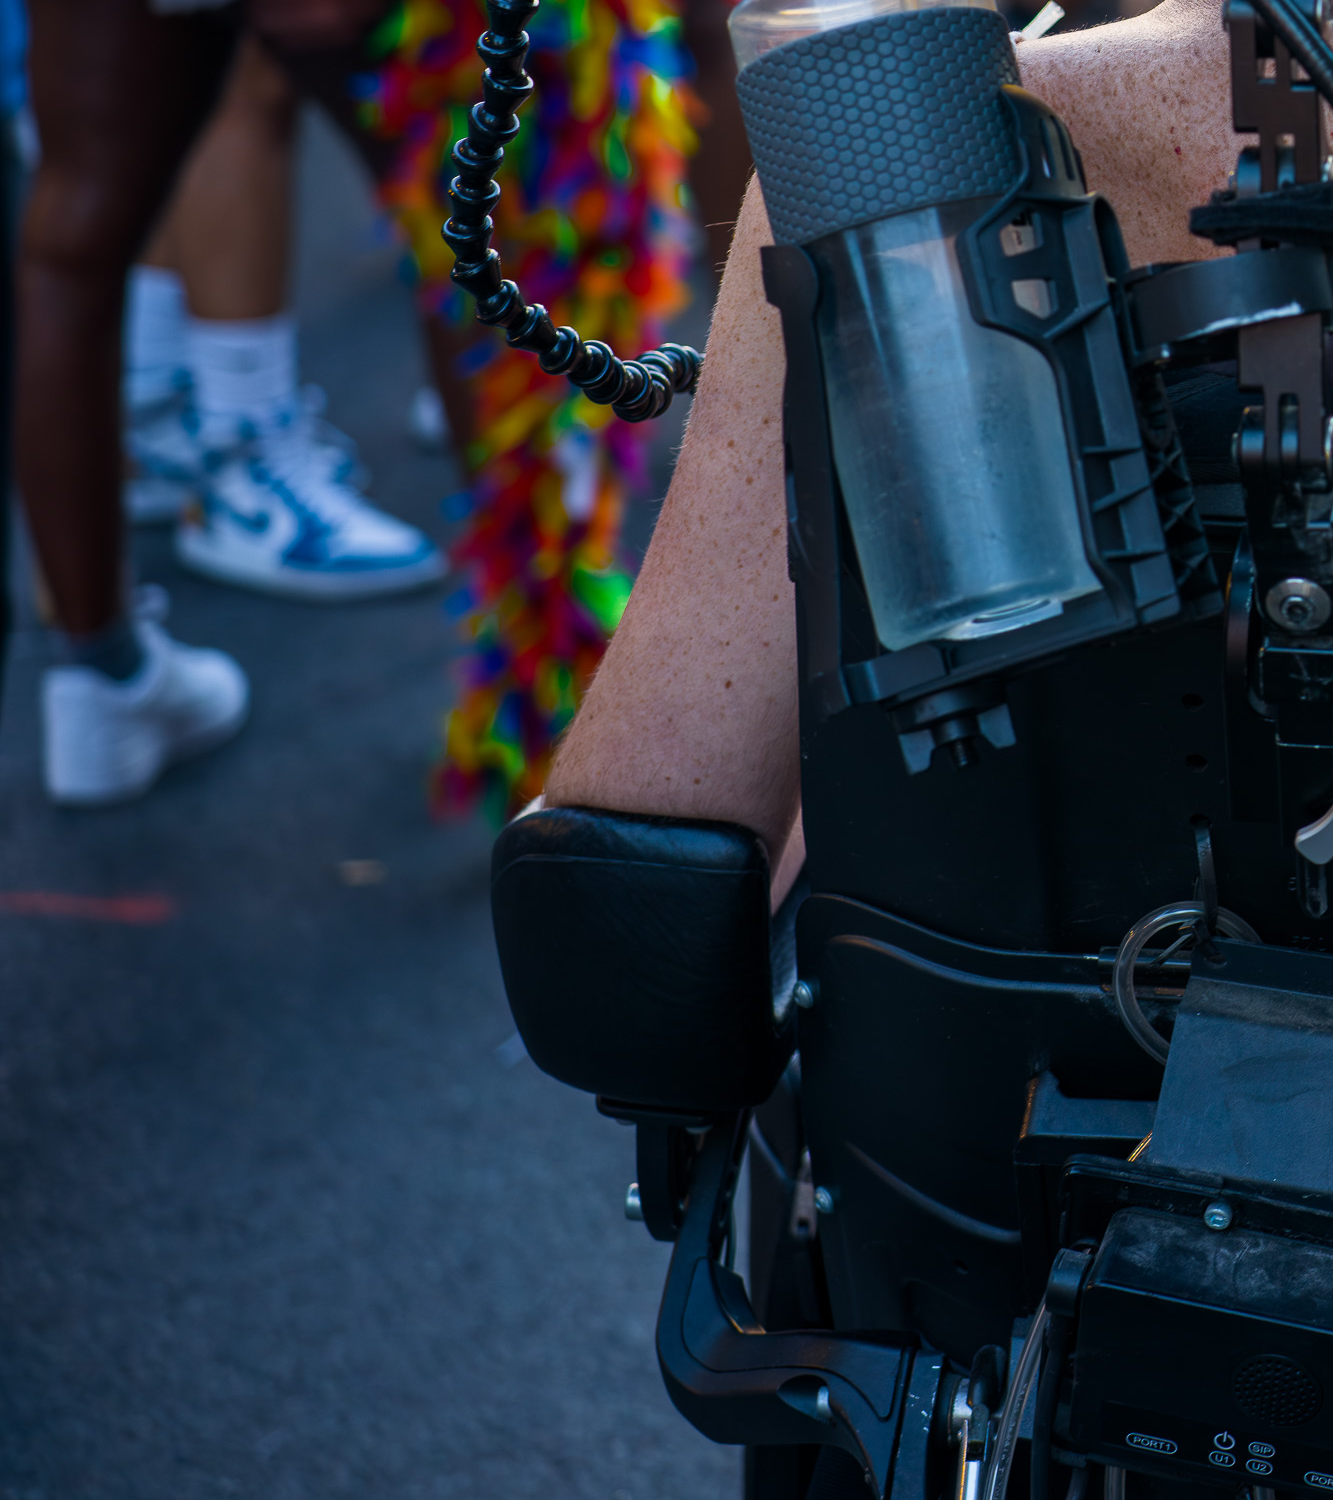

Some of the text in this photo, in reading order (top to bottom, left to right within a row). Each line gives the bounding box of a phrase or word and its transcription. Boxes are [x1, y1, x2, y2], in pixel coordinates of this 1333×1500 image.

[1132, 1435, 1172, 1452] PORT1
[1251, 1443, 1272, 1455] SIP
[1214, 1453, 1230, 1465] U1
[1251, 1460, 1268, 1473] U2
